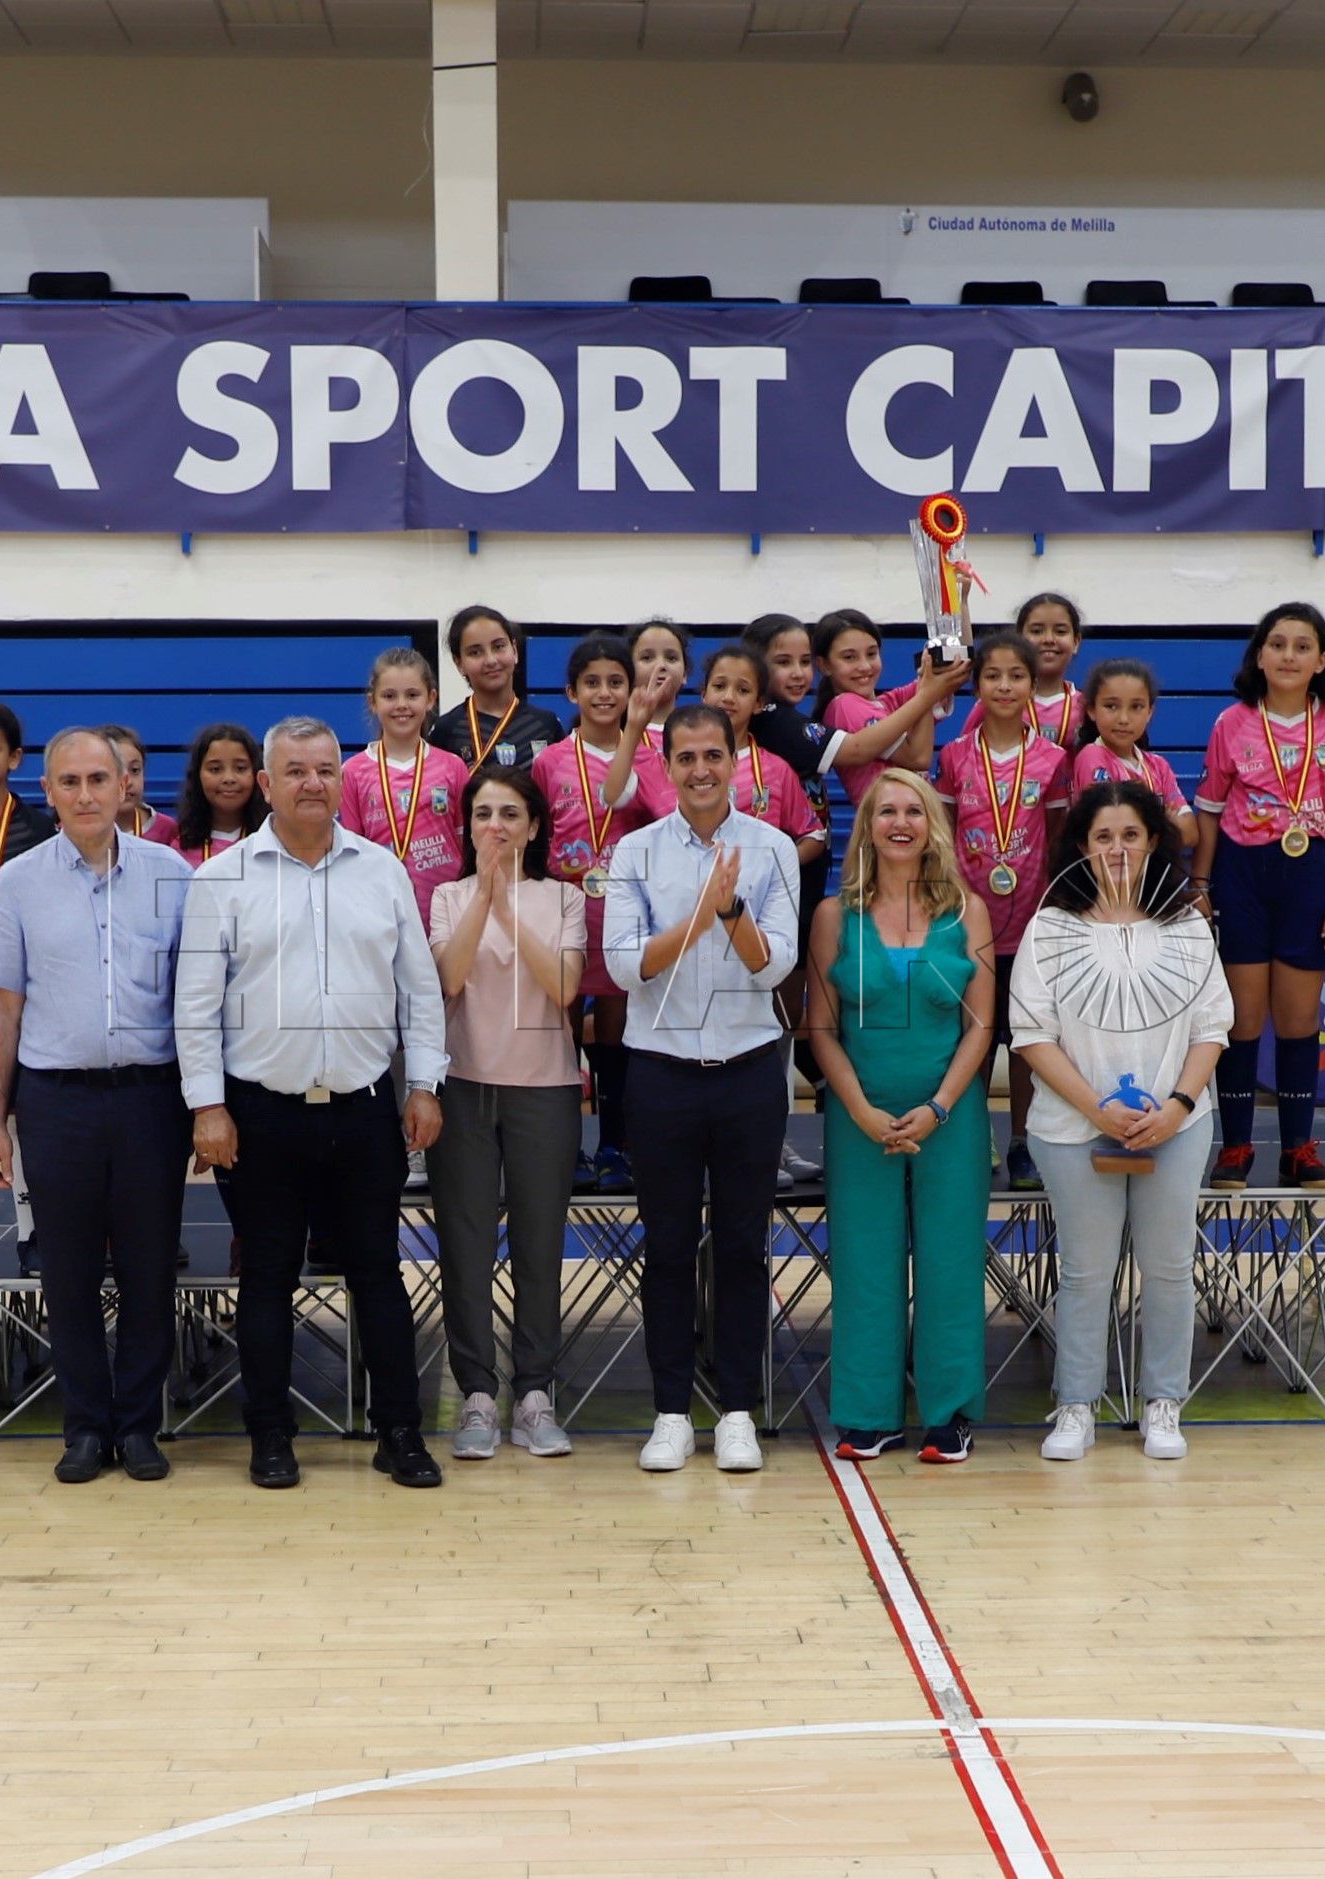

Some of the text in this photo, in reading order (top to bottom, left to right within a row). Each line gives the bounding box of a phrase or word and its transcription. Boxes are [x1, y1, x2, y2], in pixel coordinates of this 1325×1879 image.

[928, 216, 1116, 233] Ciudad Autónoma de Melilla
[174, 338, 787, 494] SPORT
[410, 834, 447, 852] MELILLA
[413, 846, 443, 863] SPORT
[415, 853, 453, 872] CAPITAL
